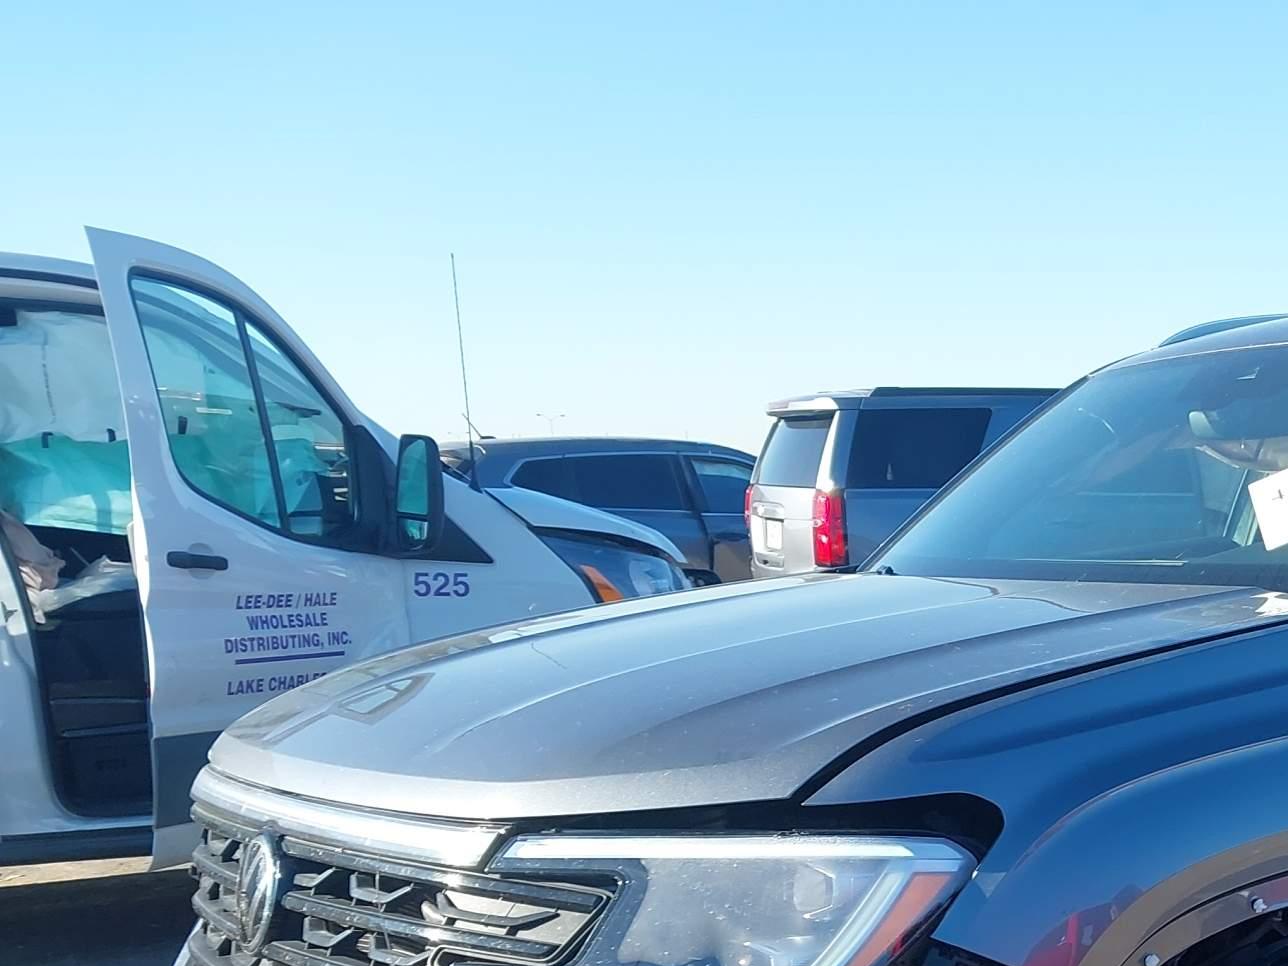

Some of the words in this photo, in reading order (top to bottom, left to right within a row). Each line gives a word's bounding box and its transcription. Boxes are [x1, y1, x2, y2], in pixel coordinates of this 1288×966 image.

[413, 572, 470, 597] 525
[235, 593, 293, 610] LEE-DEE
[303, 592, 338, 607] HALE
[246, 612, 329, 631] WHOLESALE
[223, 635, 325, 654] DISTRIBUTING,
[327, 631, 352, 647] INC.
[227, 678, 265, 696] LAKE
[268, 672, 328, 691] CHARL
